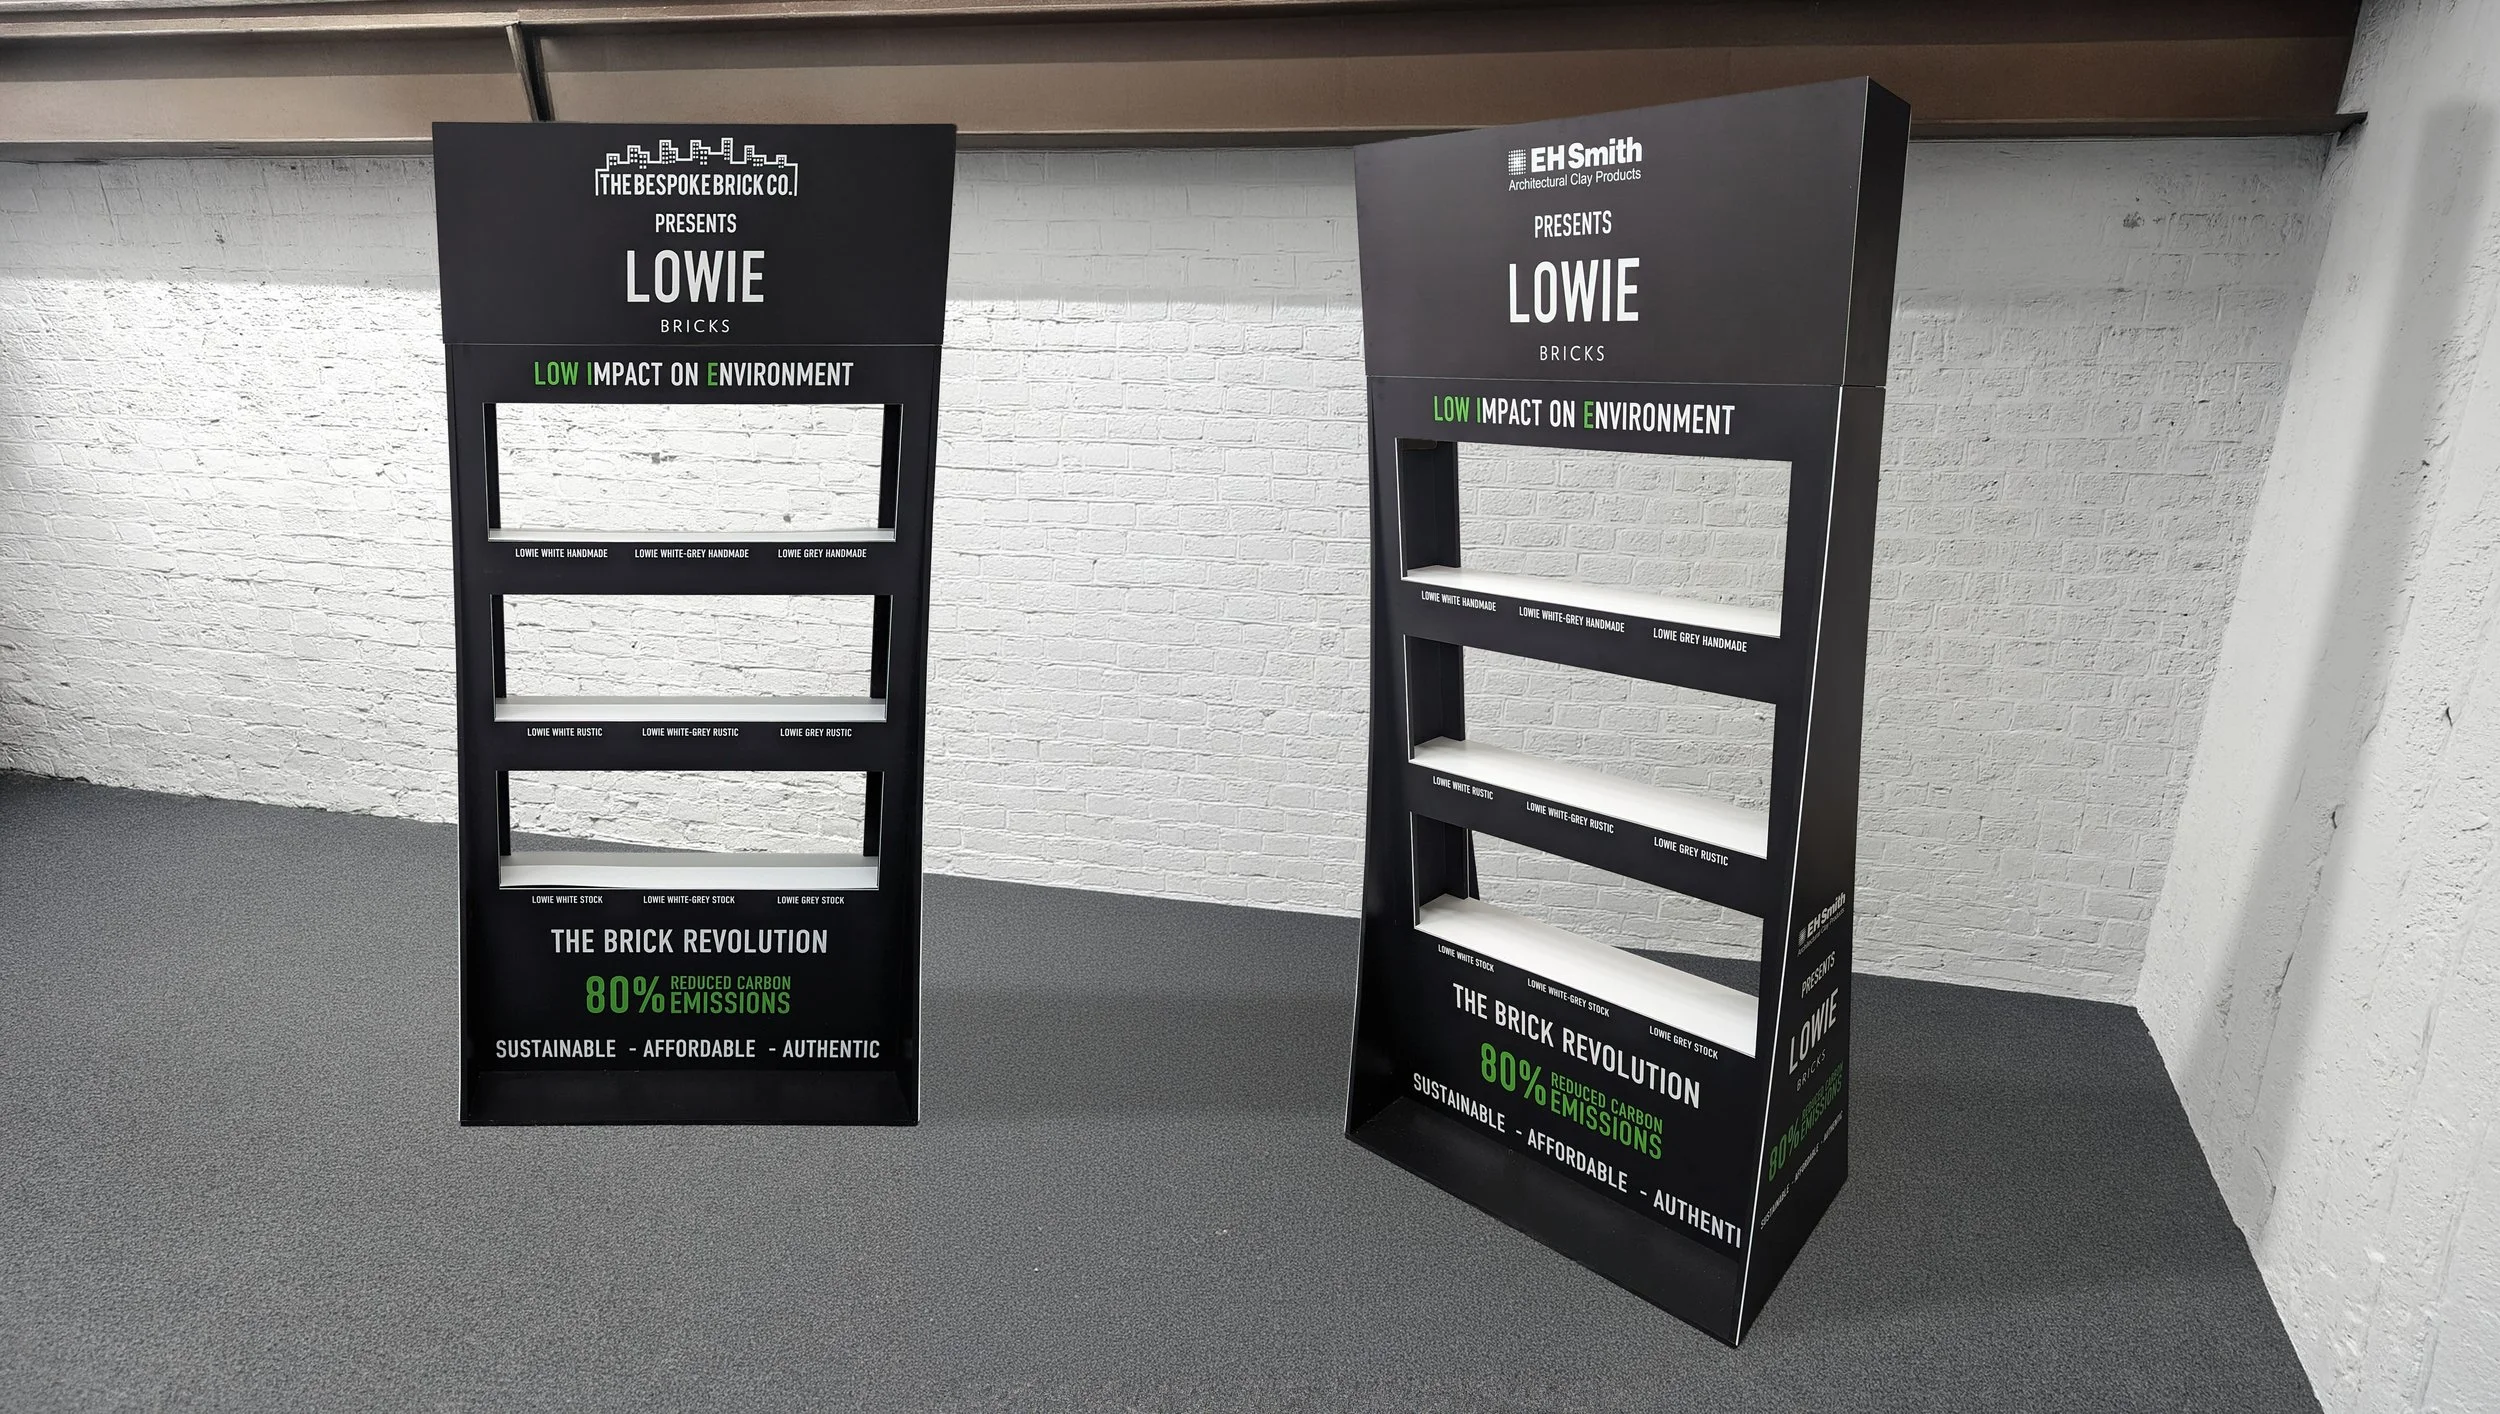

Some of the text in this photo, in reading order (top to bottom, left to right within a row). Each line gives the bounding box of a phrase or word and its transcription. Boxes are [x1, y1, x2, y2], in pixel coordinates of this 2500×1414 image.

[599, 173, 794, 197] THE BESPOKE BRICK CO.
[1508, 167, 1642, 192] Architectural Clay Products
[655, 213, 737, 234] PRESENTS
[1534, 209, 1612, 239] PRESENTS
[626, 249, 765, 304] LOWIE
[1509, 257, 1640, 324] LOWIE
[660, 319, 730, 333] BRICKS
[1539, 345, 1605, 362] BRICKS
[534, 361, 854, 387] LOW IMPACT ON ENVIRONMENT
[1434, 395, 1736, 435] LOW IMPACT ON ENVIRONMENT
[515, 548, 608, 558] LOWIE WHITE HANDMADE
[634, 548, 749, 558] LOWIE WHITE-GREY HANDMADE
[777, 548, 867, 558] LOWIE GREY HANDMADE
[1421, 590, 1497, 612] LOWIE WHITE HANDMADE
[1519, 606, 1625, 633] LOWIE WHITE-GREY HANDMADE
[1653, 627, 1748, 653] LOWIE GREY HANDMADE
[527, 727, 603, 737] LOWIE WHITE RUSTIC
[642, 727, 739, 737] LOWIE WHITE-GREY RUSTIC
[780, 728, 853, 737] LOWIE GREY RUSTIC
[1432, 775, 1494, 801] LOWIE WHITE RUSTIC
[1526, 801, 1614, 834] LOWIE WHITE-GREY RUSTIC
[1653, 836, 1729, 867] LOWIE GREY RUSTIC
[531, 895, 604, 904] LOWIE WHITE STOCK
[643, 895, 736, 904] LOWIE WHITE-GREY STOCK
[777, 895, 845, 905] LOWIE GREY STOCK
[1821, 892, 1846, 924] Smith
[550, 928, 828, 954] THE BRICK REVOLUTION
[1437, 944, 1495, 973] LOWIE WHITE STOCK
[670, 975, 791, 991] REDUCED CARBON
[1801, 951, 1836, 999] PRESENTS
[586, 975, 665, 1014] 80%
[670, 991, 791, 1015] EMISSIONS
[1527, 977, 1610, 1018] LOWIE WHITE-GREY STOCK
[1649, 1025, 1718, 1060] LOWIE GREY STOCK
[1789, 988, 1839, 1075] LOWIE
[495, 1039, 616, 1059] SUSTAINABLE
[643, 1038, 756, 1058] AFFORDABLE
[782, 1039, 880, 1059] AUTHENTIC
[1452, 982, 1700, 1109] THE BRICK REVOLUTION
[1480, 1042, 1546, 1106] 80%
[1797, 1048, 1826, 1092] BRICKS
[1551, 1071, 1663, 1135] REDUCED CARBON
[1801, 1074, 1842, 1141] EMISSIONS
[1551, 1093, 1662, 1160] EMISSIONS
[1413, 1073, 1505, 1134] SUSTAINABLE
[1528, 1128, 1628, 1193] AFFORDABLE
[1653, 1189, 1741, 1249] AUTHENTI
[1769, 1117, 1800, 1182] 80%
